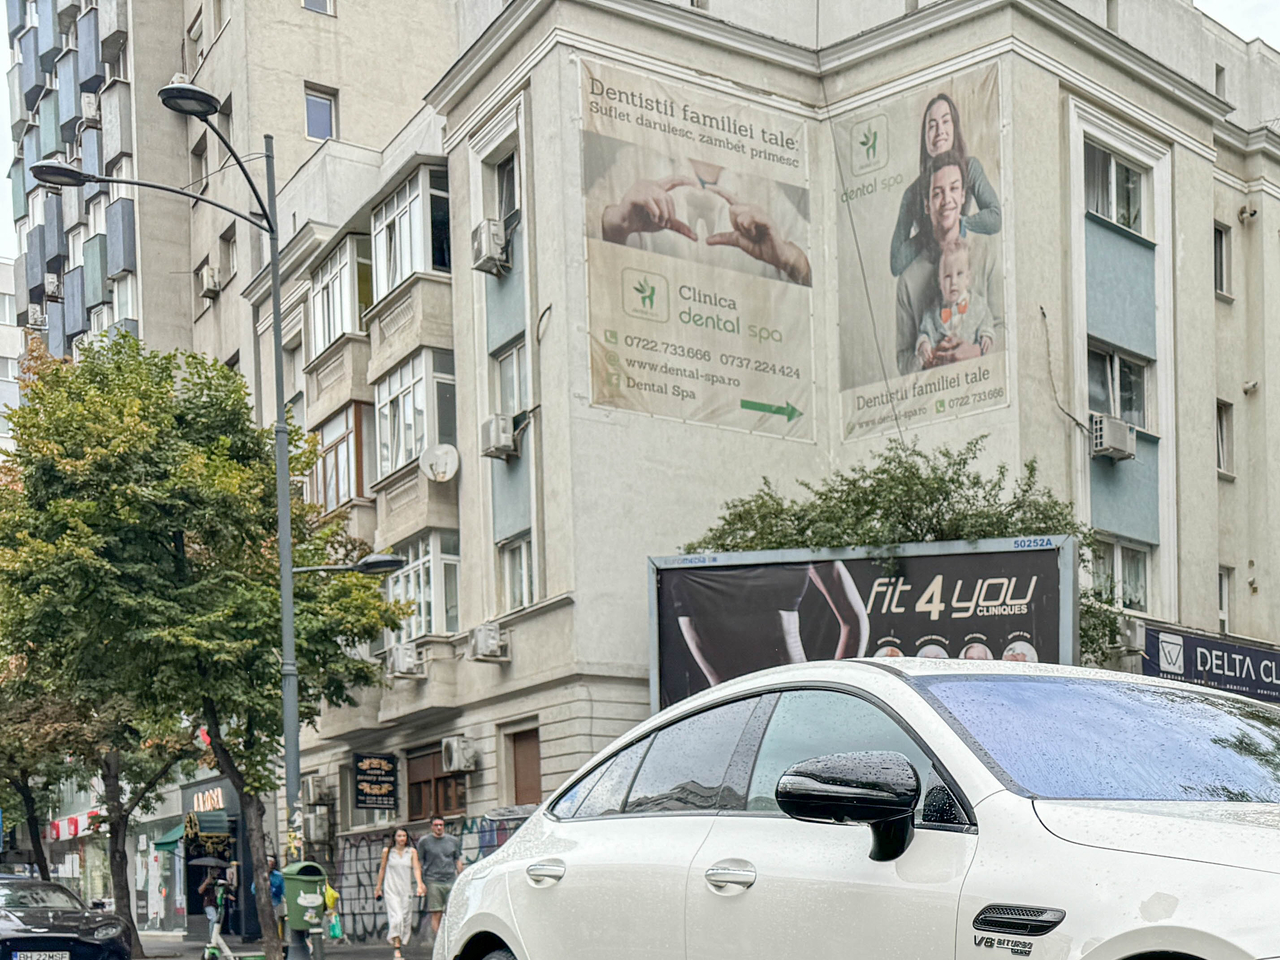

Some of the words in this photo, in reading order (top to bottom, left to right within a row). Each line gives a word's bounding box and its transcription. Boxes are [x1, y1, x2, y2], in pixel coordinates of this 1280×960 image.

[590, 78, 674, 118] Dentistii
[682, 104, 754, 140] familiei
[761, 127, 800, 152] tale:
[590, 101, 631, 123] Suflet
[636, 114, 695, 141] daruiesc,
[699, 131, 746, 154] zambet
[751, 148, 800, 168] primesc
[679, 285, 738, 310] Clinica
[679, 307, 740, 334] dental
[748, 324, 783, 344] spa
[624, 335, 712, 362] 0722.733.666
[720, 354, 800, 379] 0737.224.424
[625, 357, 740, 387] www.dental-spa.ro
[626, 377, 668, 395] Dental
[672, 385, 696, 400] Spa
[912, 373, 960, 397] familiei
[965, 366, 990, 385] tale
[1014, 538, 1052, 548] 50252A
[867, 577, 912, 614] fit
[915, 574, 945, 620] 4
[951, 576, 1038, 618] you
[976, 605, 1028, 616] CLINIQUES
[1196, 647, 1256, 680] DELTA
[974, 935, 995, 948] V8
[996, 938, 1033, 950] BITURBO
